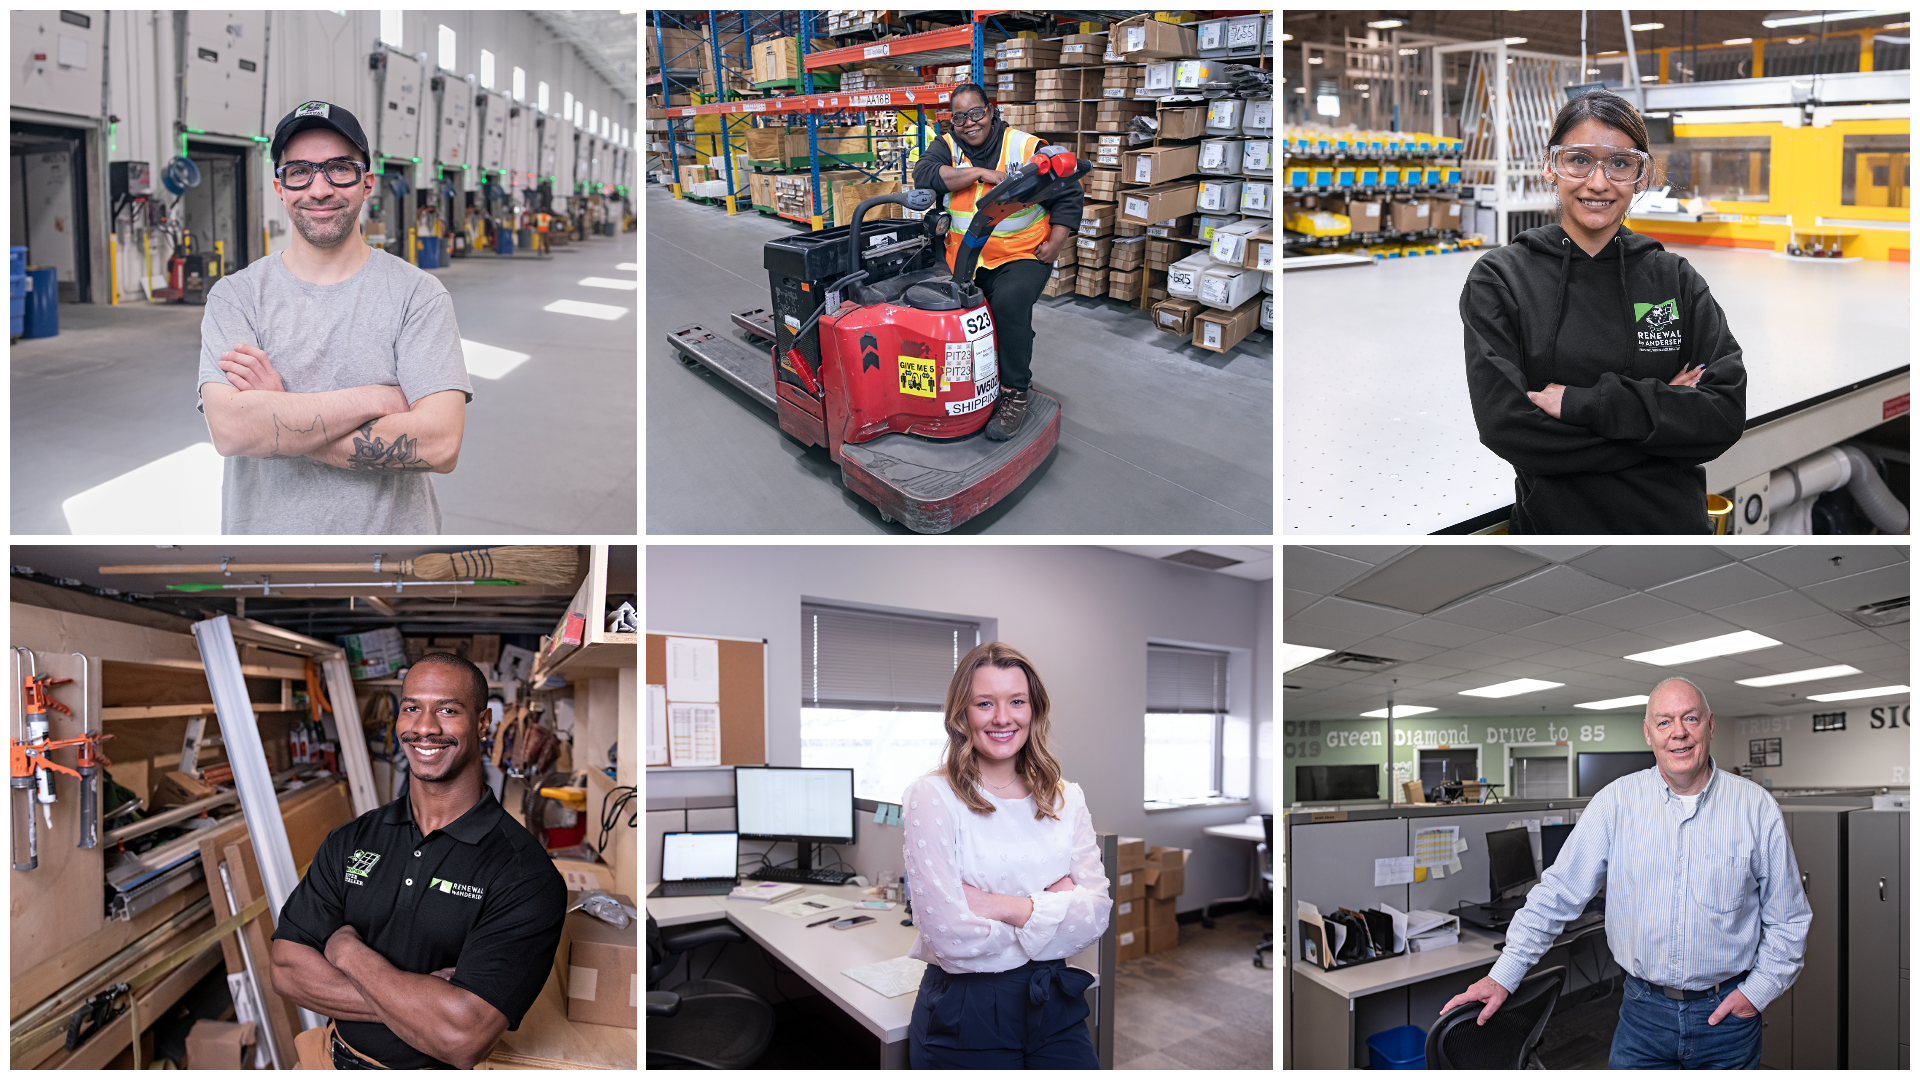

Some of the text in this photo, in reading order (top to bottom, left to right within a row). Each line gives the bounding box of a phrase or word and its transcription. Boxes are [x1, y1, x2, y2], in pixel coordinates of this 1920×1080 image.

[966, 312, 991, 335] S23
[1637, 330, 1681, 340] RENEWAL
[1645, 338, 1682, 347] ANDERSEN
[945, 351, 972, 361] PIT23
[900, 361, 935, 373] GIVE ME 5
[945, 366, 971, 377] PIT23
[1740, 716, 1793, 735] TRUST
[1326, 722, 1605, 748] Green Diamond Drive to 85
[1892, 766, 1910, 783] R
[452, 882, 484, 895] RENEWAL
